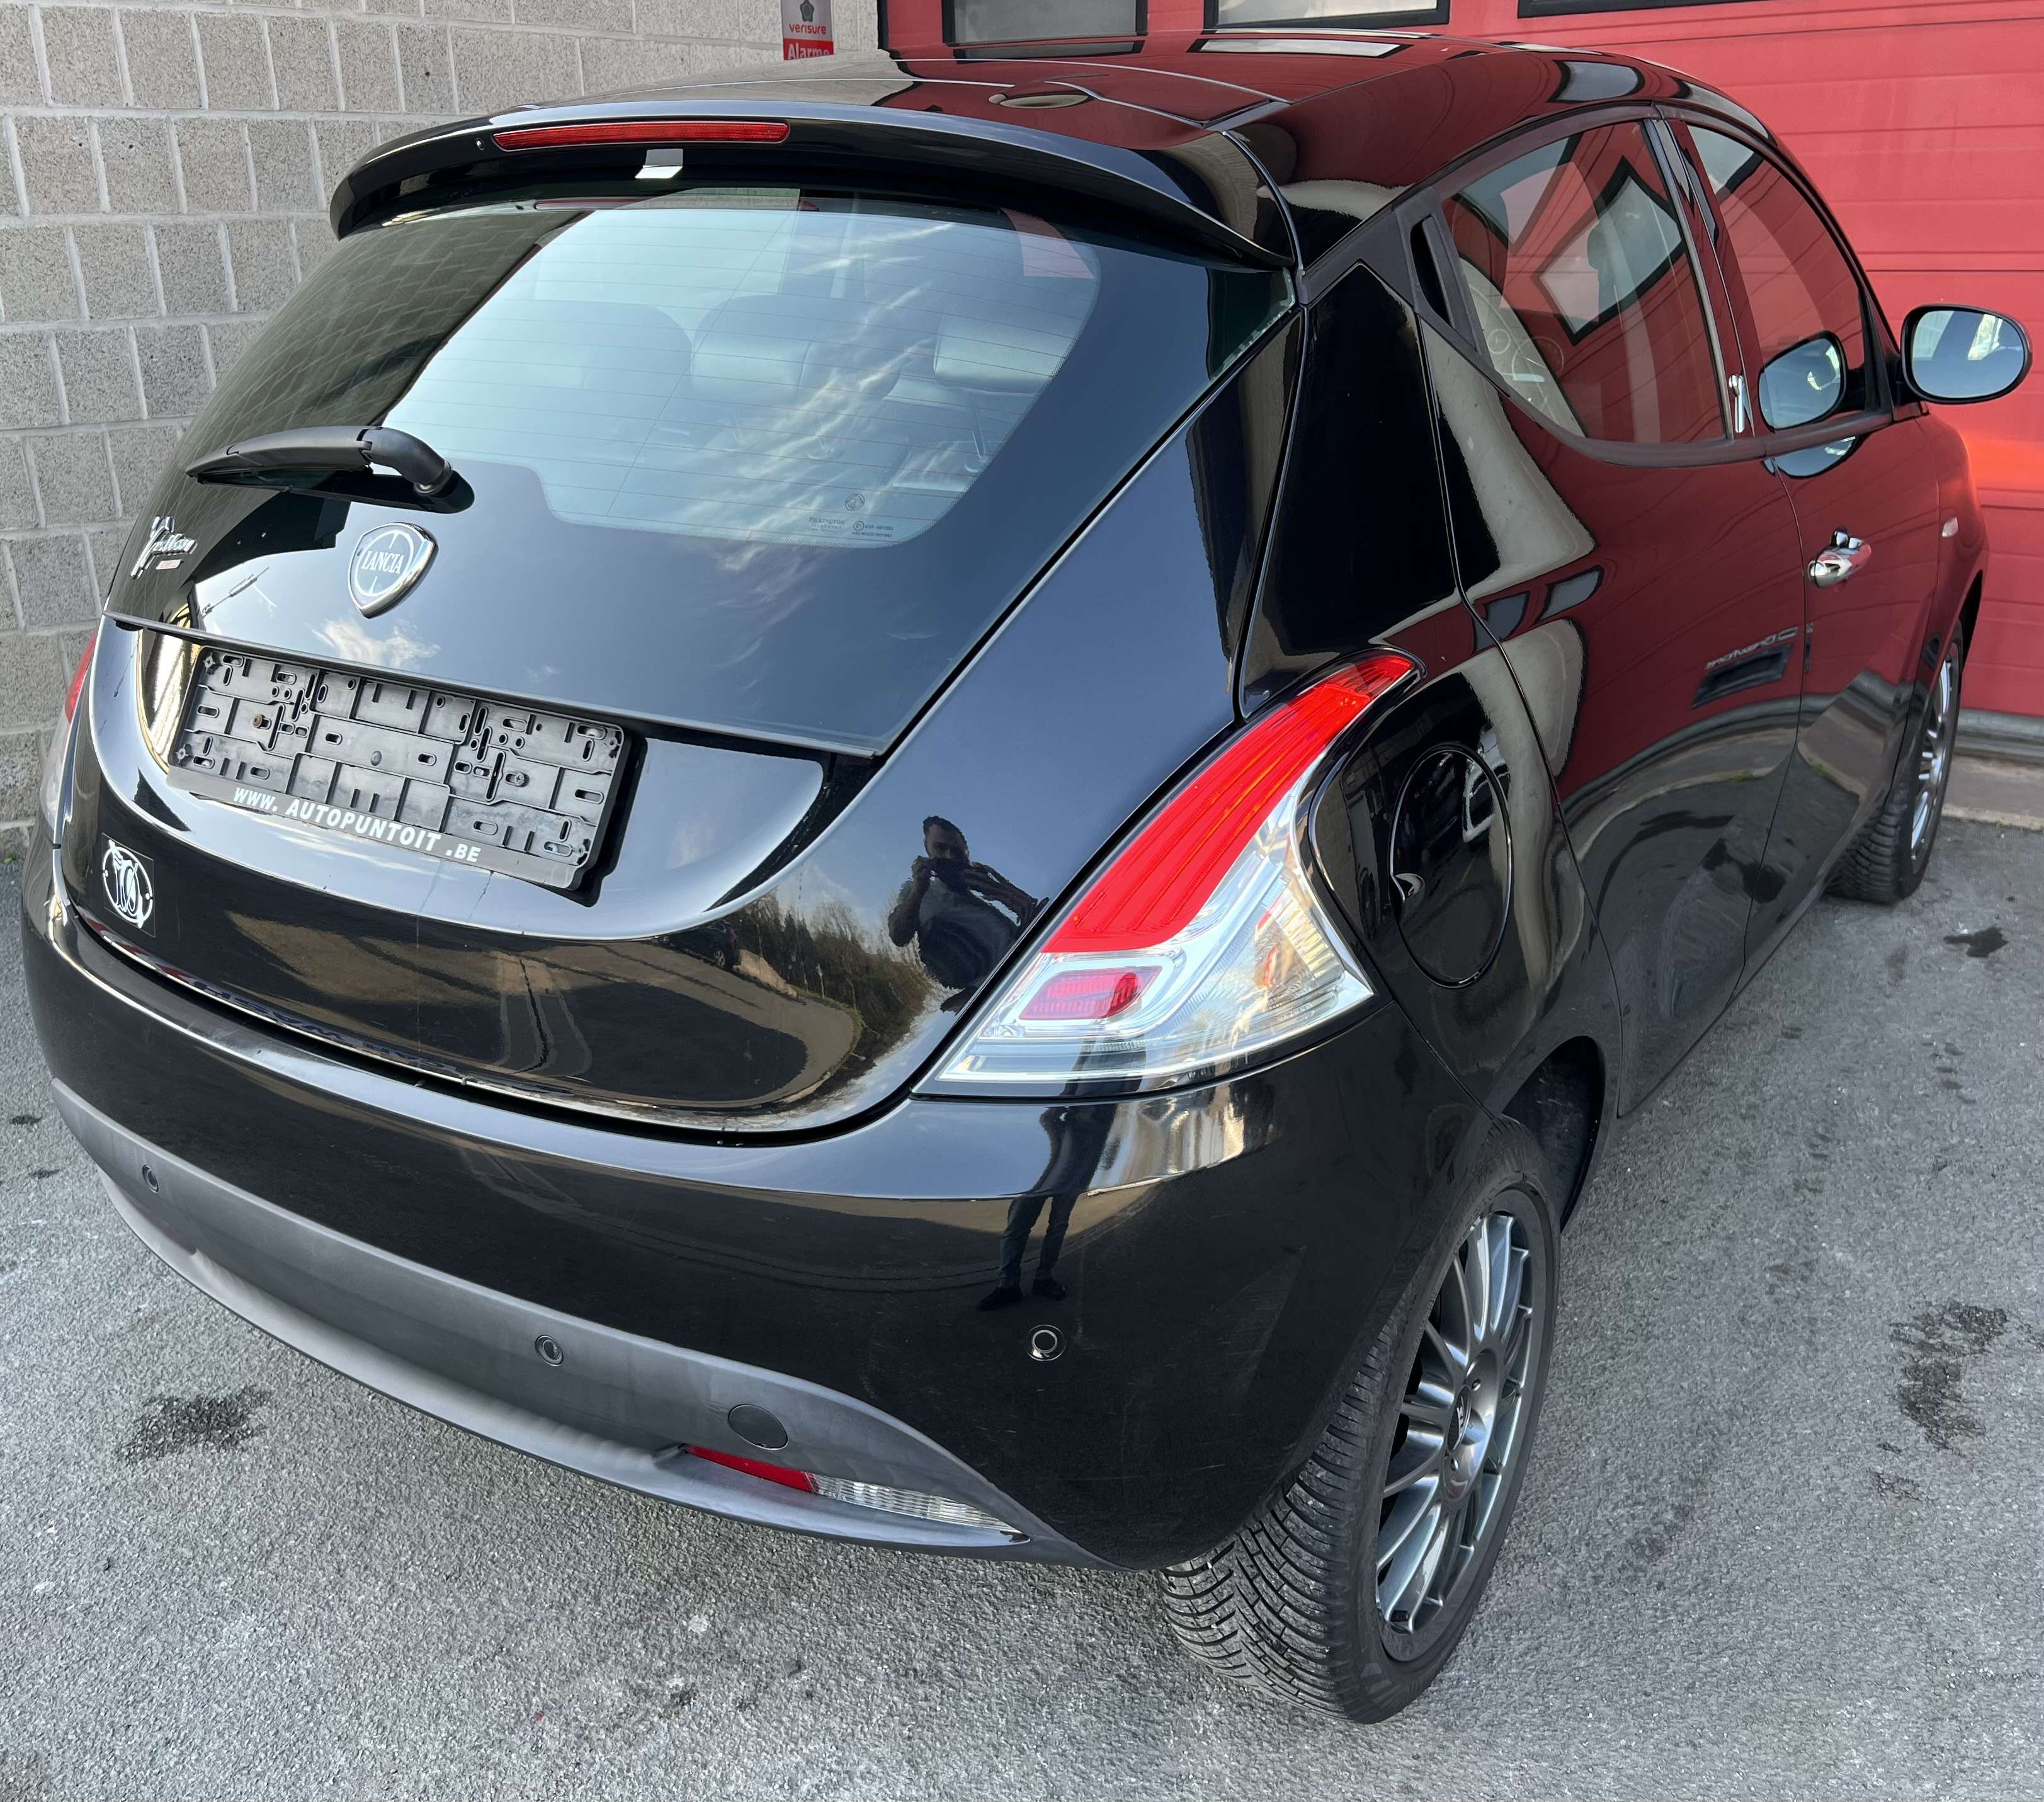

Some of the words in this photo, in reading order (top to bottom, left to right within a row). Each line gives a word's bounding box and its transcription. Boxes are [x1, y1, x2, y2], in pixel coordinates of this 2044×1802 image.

[361, 550, 404, 574] LANCIA
[234, 787, 278, 811] WWW.
[285, 799, 441, 852] AUTOPUNTOIT
[446, 843, 481, 863] .BE
